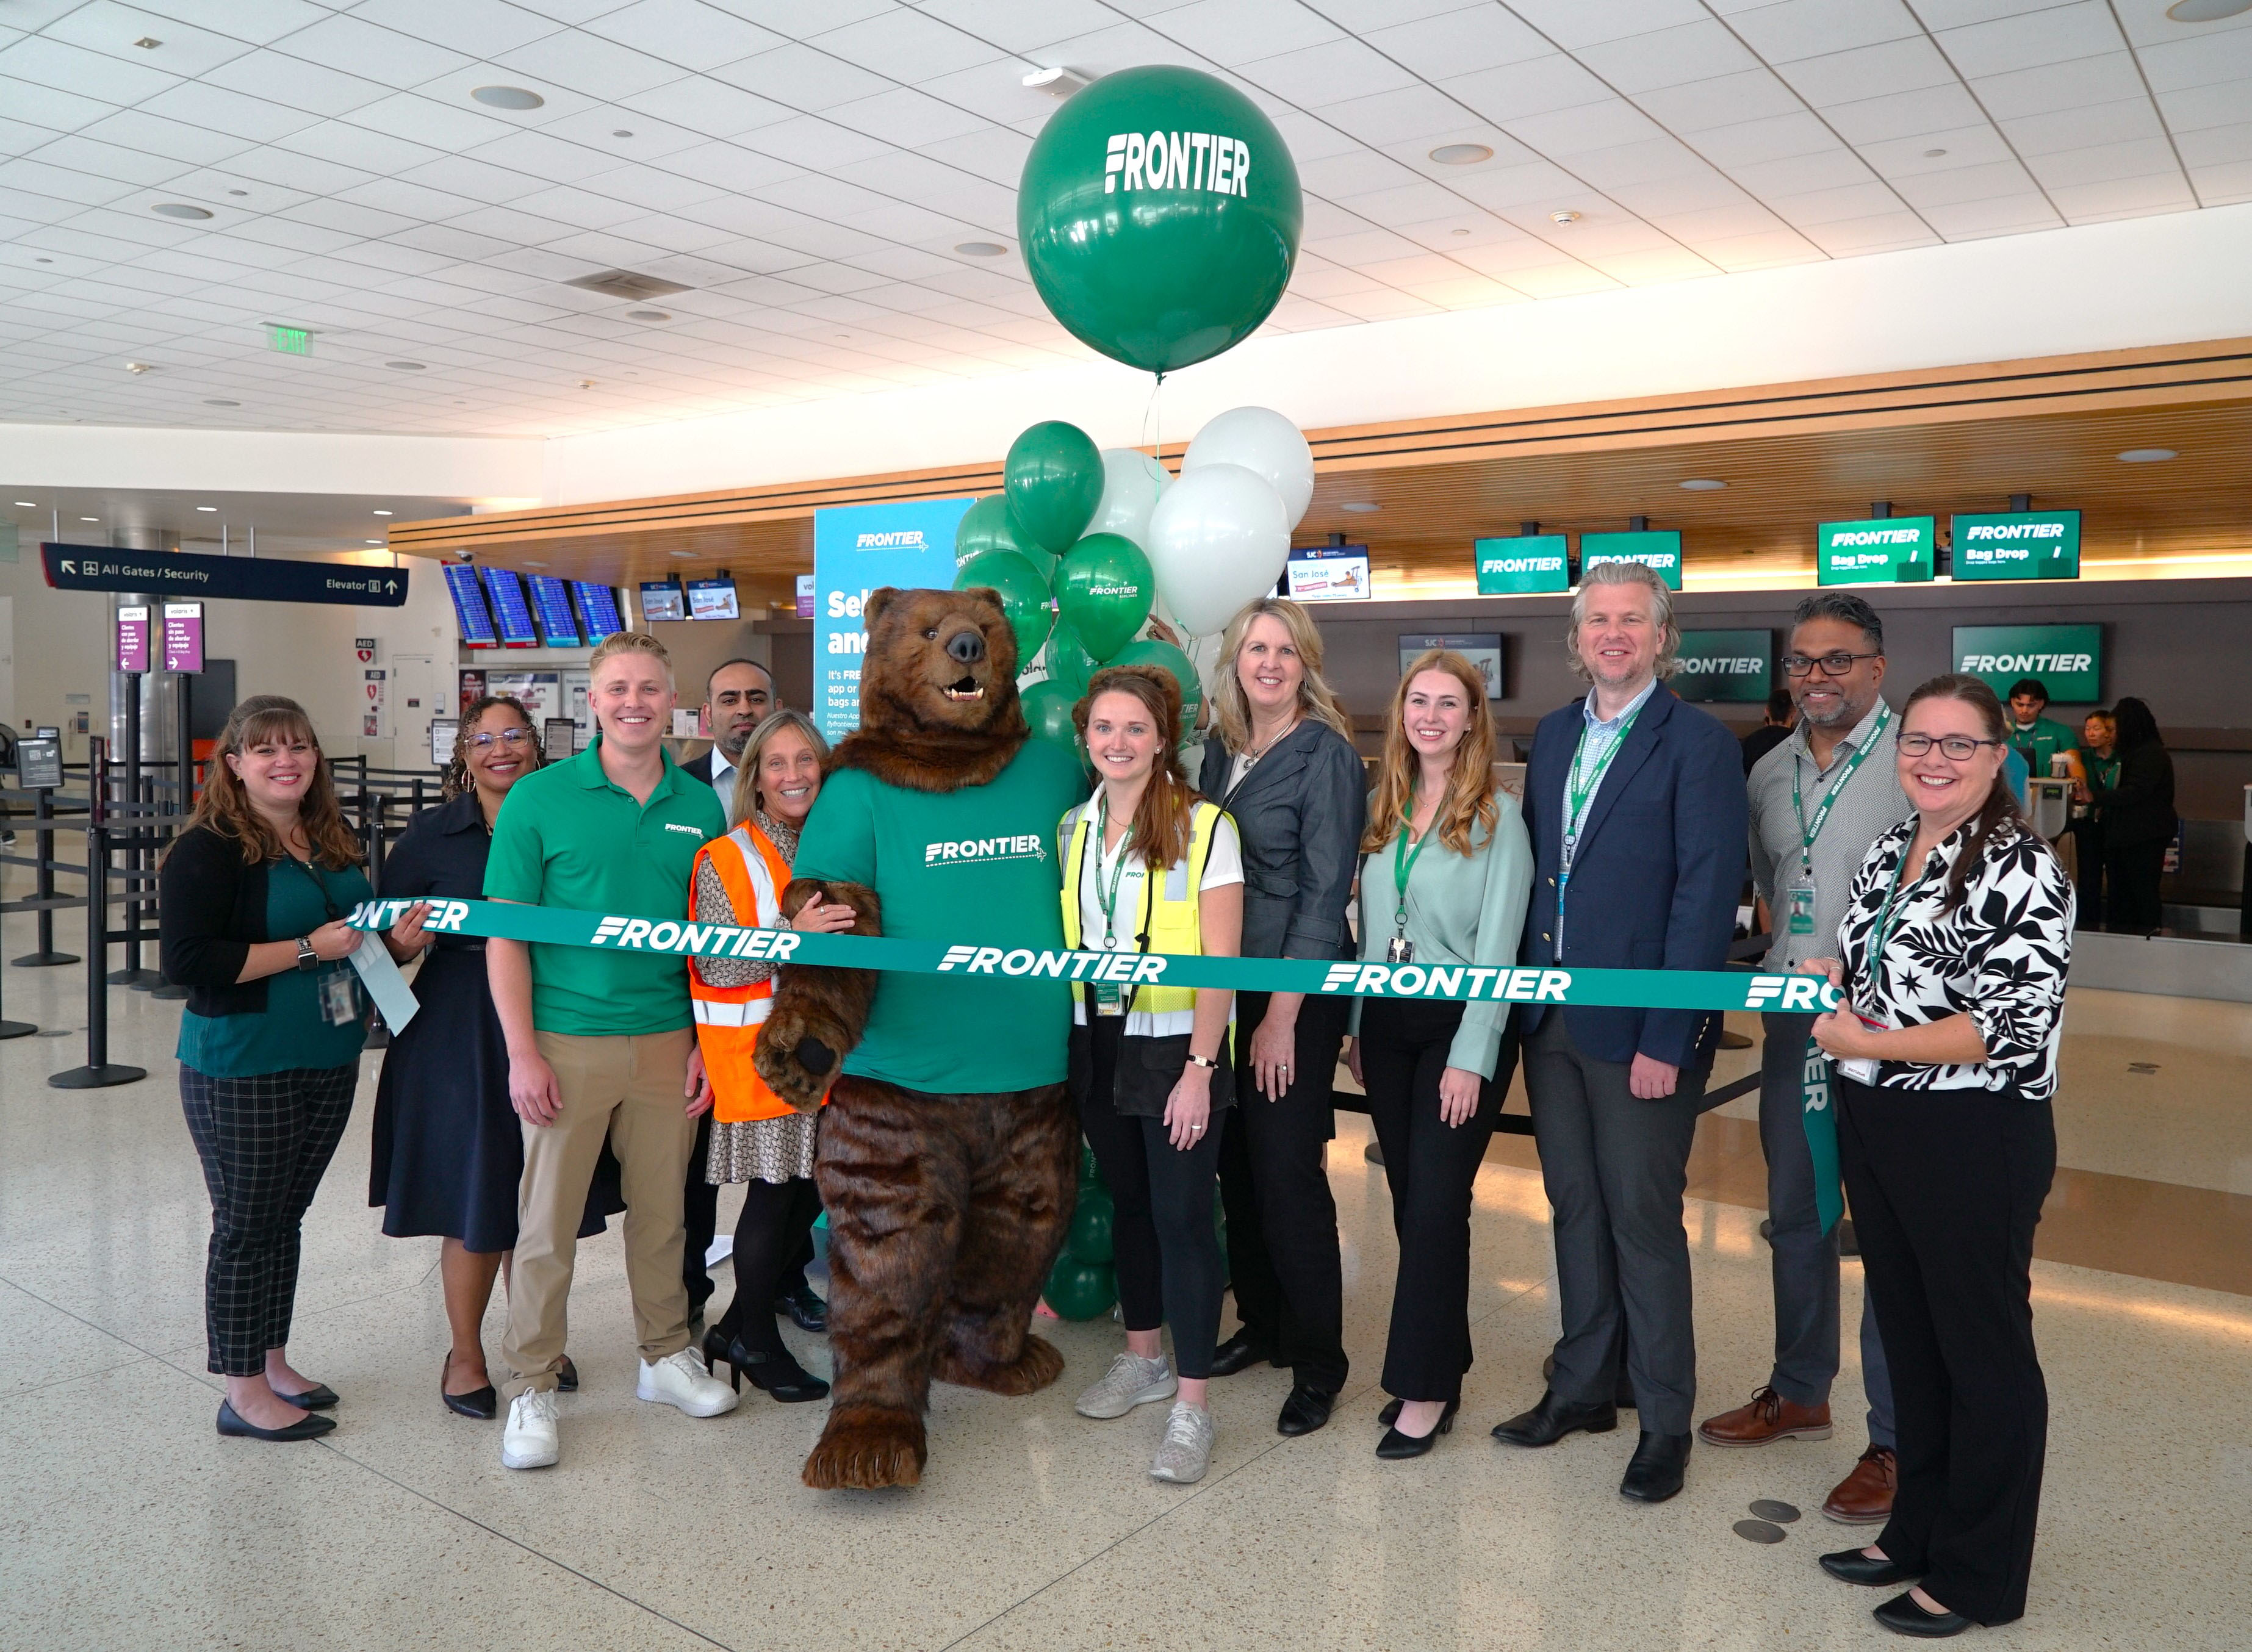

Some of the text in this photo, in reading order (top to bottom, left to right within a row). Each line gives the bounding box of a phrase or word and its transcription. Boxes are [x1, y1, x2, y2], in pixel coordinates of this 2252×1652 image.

[1104, 131, 1250, 198] FRONTIER
[277, 327, 307, 353] EXIT
[856, 531, 923, 547] FRONTIER
[1831, 529, 1920, 547] FRONTIER
[1966, 523, 2064, 540] FRONTIER
[1831, 554, 1889, 566] Bag Drop
[1966, 548, 2029, 561] Bag Drop
[102, 565, 209, 583] All Gates / Security
[1481, 557, 1563, 573] FRONTIER
[326, 579, 366, 591] Elevator
[1089, 586, 1138, 595] FRONTIER
[827, 589, 873, 618] Sel
[1960, 654, 2092, 672] FRONTIER
[370, 671, 381, 680] AED
[828, 685, 857, 695] app or
[828, 697, 849, 708] bags
[1603, 736, 1622, 761] FRONTIER
[1859, 725, 1880, 756] FRONTIER
[1581, 769, 1599, 795] FRONTIER
[1831, 764, 1854, 795] FRONTIER
[665, 824, 702, 835] FRONTIER
[1808, 805, 1827, 838] FRONTIER
[925, 835, 1041, 862] FRONTIER
[1111, 866, 1121, 894] FRONTIER
[591, 916, 800, 960] FRONTIER
[937, 945, 1167, 983] FRONTIER
[1321, 963, 1572, 1001] FRONTIER
